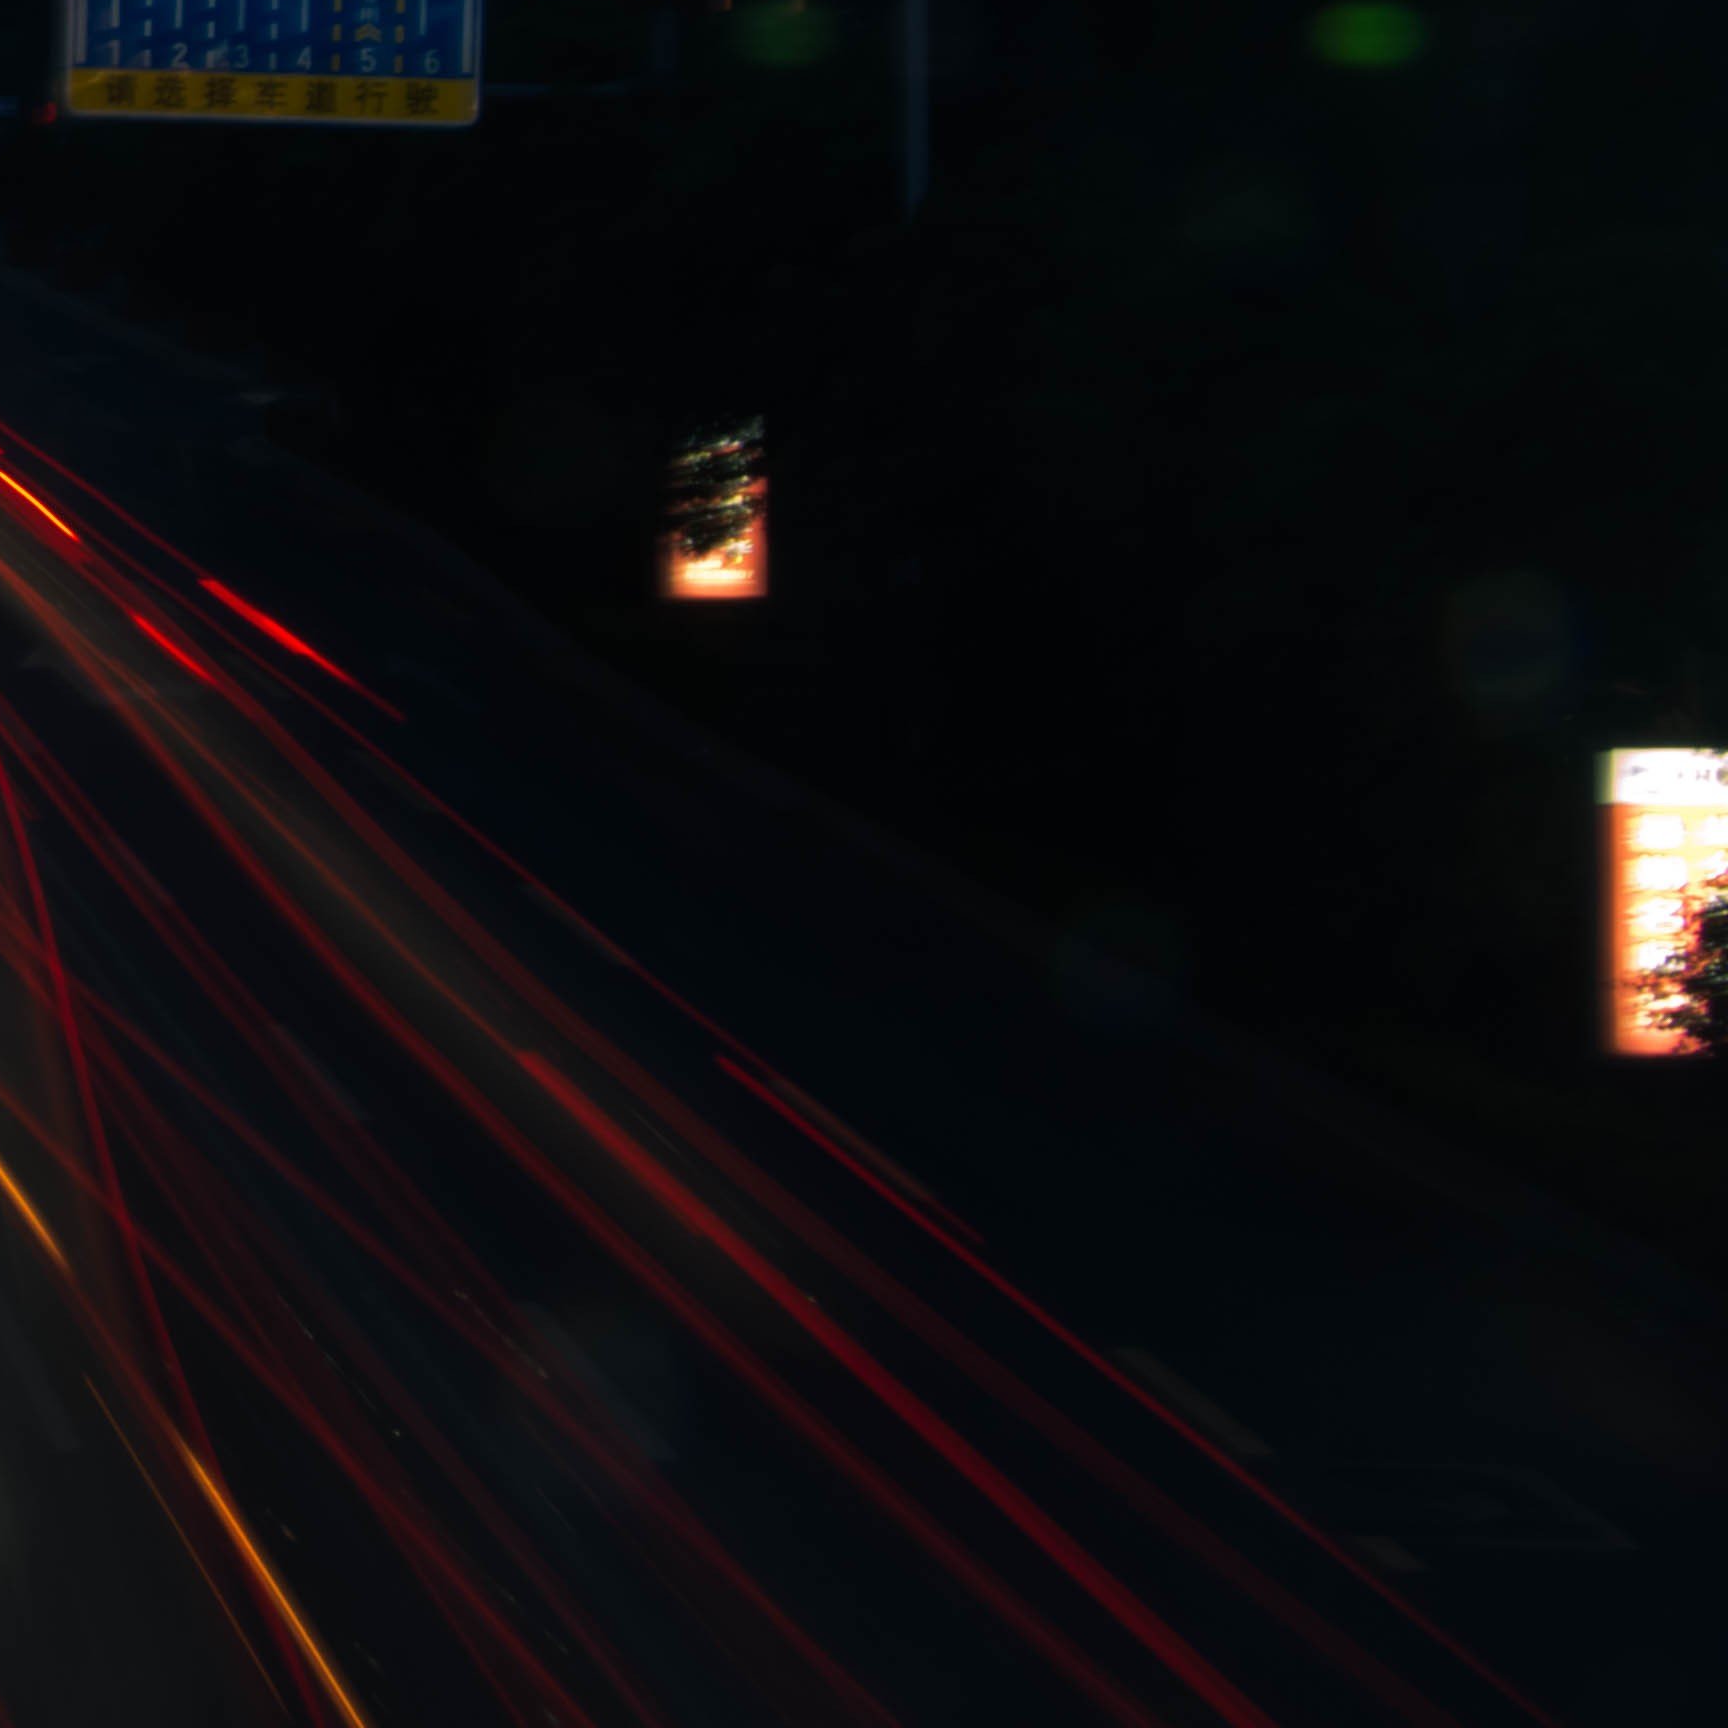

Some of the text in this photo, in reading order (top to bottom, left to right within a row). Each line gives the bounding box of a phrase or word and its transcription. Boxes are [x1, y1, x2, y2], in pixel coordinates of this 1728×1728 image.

[171, 42, 191, 69] 2
[231, 43, 250, 69] 3
[296, 46, 314, 71] 4
[360, 47, 378, 73] 5
[424, 49, 442, 74] 6
[106, 75, 439, 115] 请选择车道行驶
